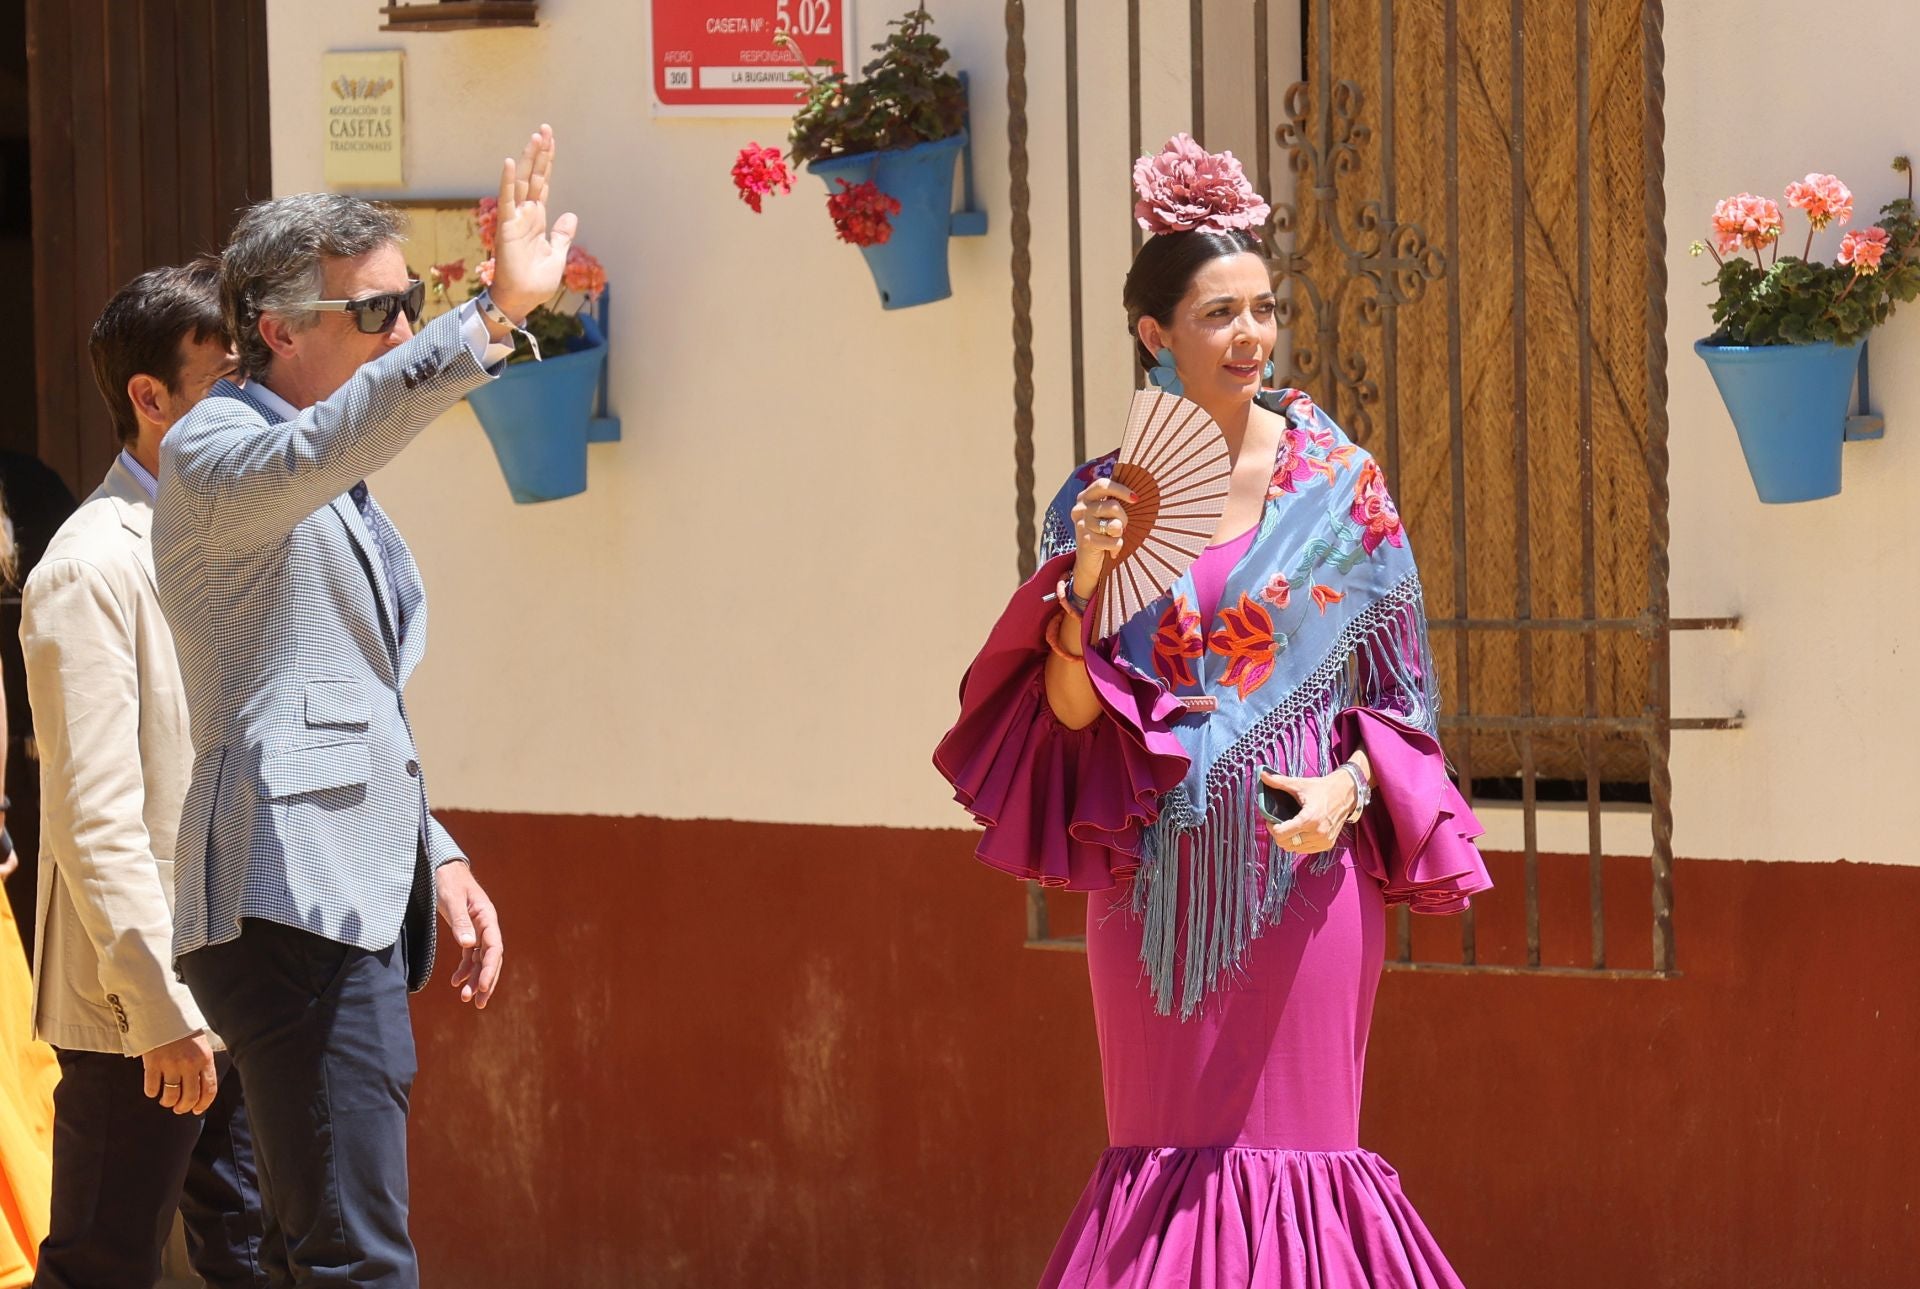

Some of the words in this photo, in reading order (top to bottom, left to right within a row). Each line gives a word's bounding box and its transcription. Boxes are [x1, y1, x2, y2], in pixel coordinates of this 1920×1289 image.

[706, 18, 748, 34] CASETA
[775, 0, 831, 35] 5.02
[664, 51, 692, 62] AFORO
[740, 51, 801, 62] RESPONSABL
[670, 72, 687, 84] 300
[732, 72, 742, 83] LA
[329, 118, 392, 137] CASETAS
[330, 141, 392, 152] TRADICIONALES
